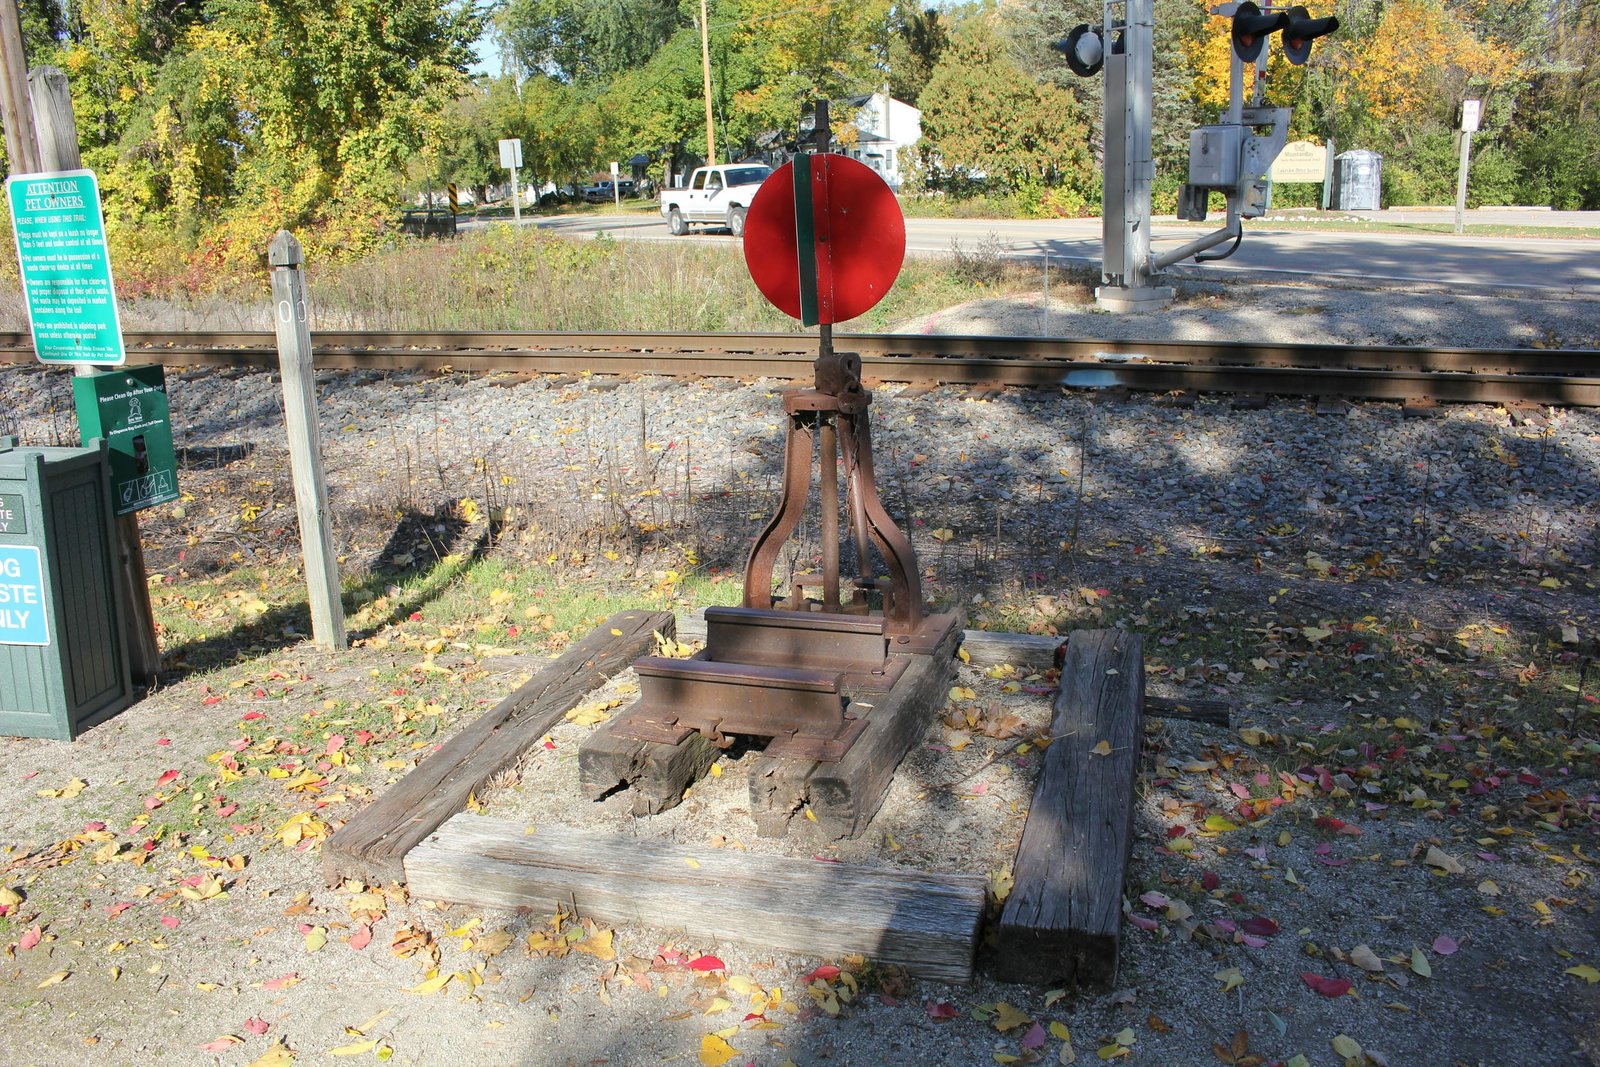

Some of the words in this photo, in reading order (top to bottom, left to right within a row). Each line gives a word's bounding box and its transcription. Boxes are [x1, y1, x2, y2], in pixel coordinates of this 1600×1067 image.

[26, 180, 78, 195] ATTENTION
[25, 198, 41, 210] PET
[44, 195, 84, 208] OWNERS
